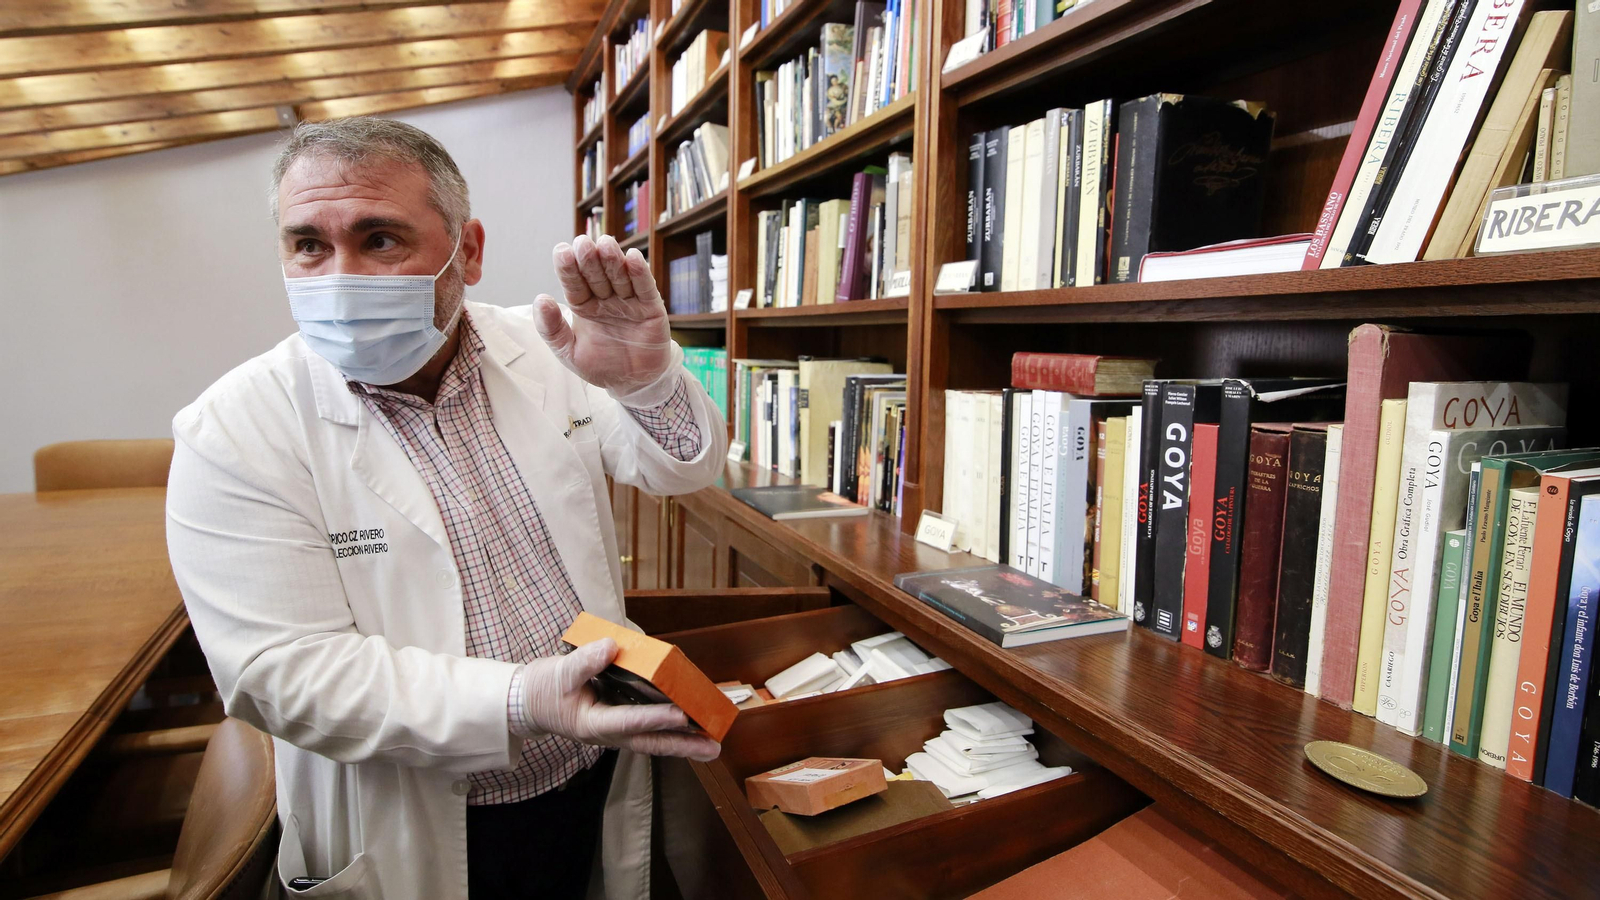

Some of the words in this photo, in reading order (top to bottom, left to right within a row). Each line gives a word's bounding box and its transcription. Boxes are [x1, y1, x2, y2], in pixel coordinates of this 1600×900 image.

[1384, 38, 1397, 62] Nacional
[1397, 13, 1407, 31] Prado
[1459, 0, 1515, 82] BERA
[1367, 93, 1406, 164] RIBERA
[1537, 127, 1546, 146] PRADO
[1307, 238, 1318, 257] LOS
[1315, 192, 1338, 236] BASSANO
[1444, 395, 1521, 429] GOYA
[1020, 426, 1029, 465] GOYA
[1031, 412, 1041, 456] GOYA
[1044, 414, 1056, 459] GOYA
[1059, 426, 1069, 456] Goya
[1075, 427, 1085, 460] GOYA
[1162, 422, 1187, 510] GOYA
[1250, 455, 1281, 468] GOYA
[1425, 441, 1443, 489] GOYA
[1289, 483, 1319, 492] CAPRICHOS
[1404, 467, 1418, 506] Completa
[1018, 484, 1027, 530] ITALIA
[1028, 479, 1038, 529] ITALIA
[1042, 482, 1052, 534] ITALIA
[1138, 482, 1149, 523] GOYA
[1510, 497, 1521, 513] DE
[1567, 504, 1575, 520] mirada
[924, 524, 946, 540] GOYA
[1214, 497, 1228, 541] GOYA
[1400, 508, 1412, 538] Gráfica
[1506, 515, 1519, 546] GOYA
[1518, 509, 1535, 545] Lafuente
[1563, 526, 1573, 542] Goya
[329, 532, 347, 545] RICO
[349, 531, 358, 541] CZ
[360, 528, 384, 541] RIVERO
[364, 543, 388, 555] RIVERO
[1189, 518, 1206, 555] Goya
[1398, 540, 1408, 560] Obra
[1371, 541, 1382, 575] GOYA
[1504, 550, 1515, 567] EN
[1515, 545, 1531, 571] Ferrari
[1443, 562, 1458, 590] GOYA
[1472, 570, 1483, 596] l'Italia
[1501, 568, 1513, 592] SUS
[1512, 581, 1527, 595] EL
[1389, 568, 1409, 625] GOYA
[1579, 586, 1591, 604] Goya
[1469, 602, 1481, 622] Goya
[1495, 592, 1510, 639] DIBUJOS
[1507, 596, 1525, 643] MUNDO
[1577, 610, 1588, 618] el
[1573, 617, 1587, 644] infante
[1570, 657, 1581, 673] Luis
[1572, 643, 1584, 658] don
[1360, 661, 1368, 692] HYPERION
[1385, 651, 1394, 688] CASARIEGO
[1569, 673, 1579, 683] de
[1565, 682, 1578, 709] Borbón
[1512, 681, 1537, 763] GOYA
